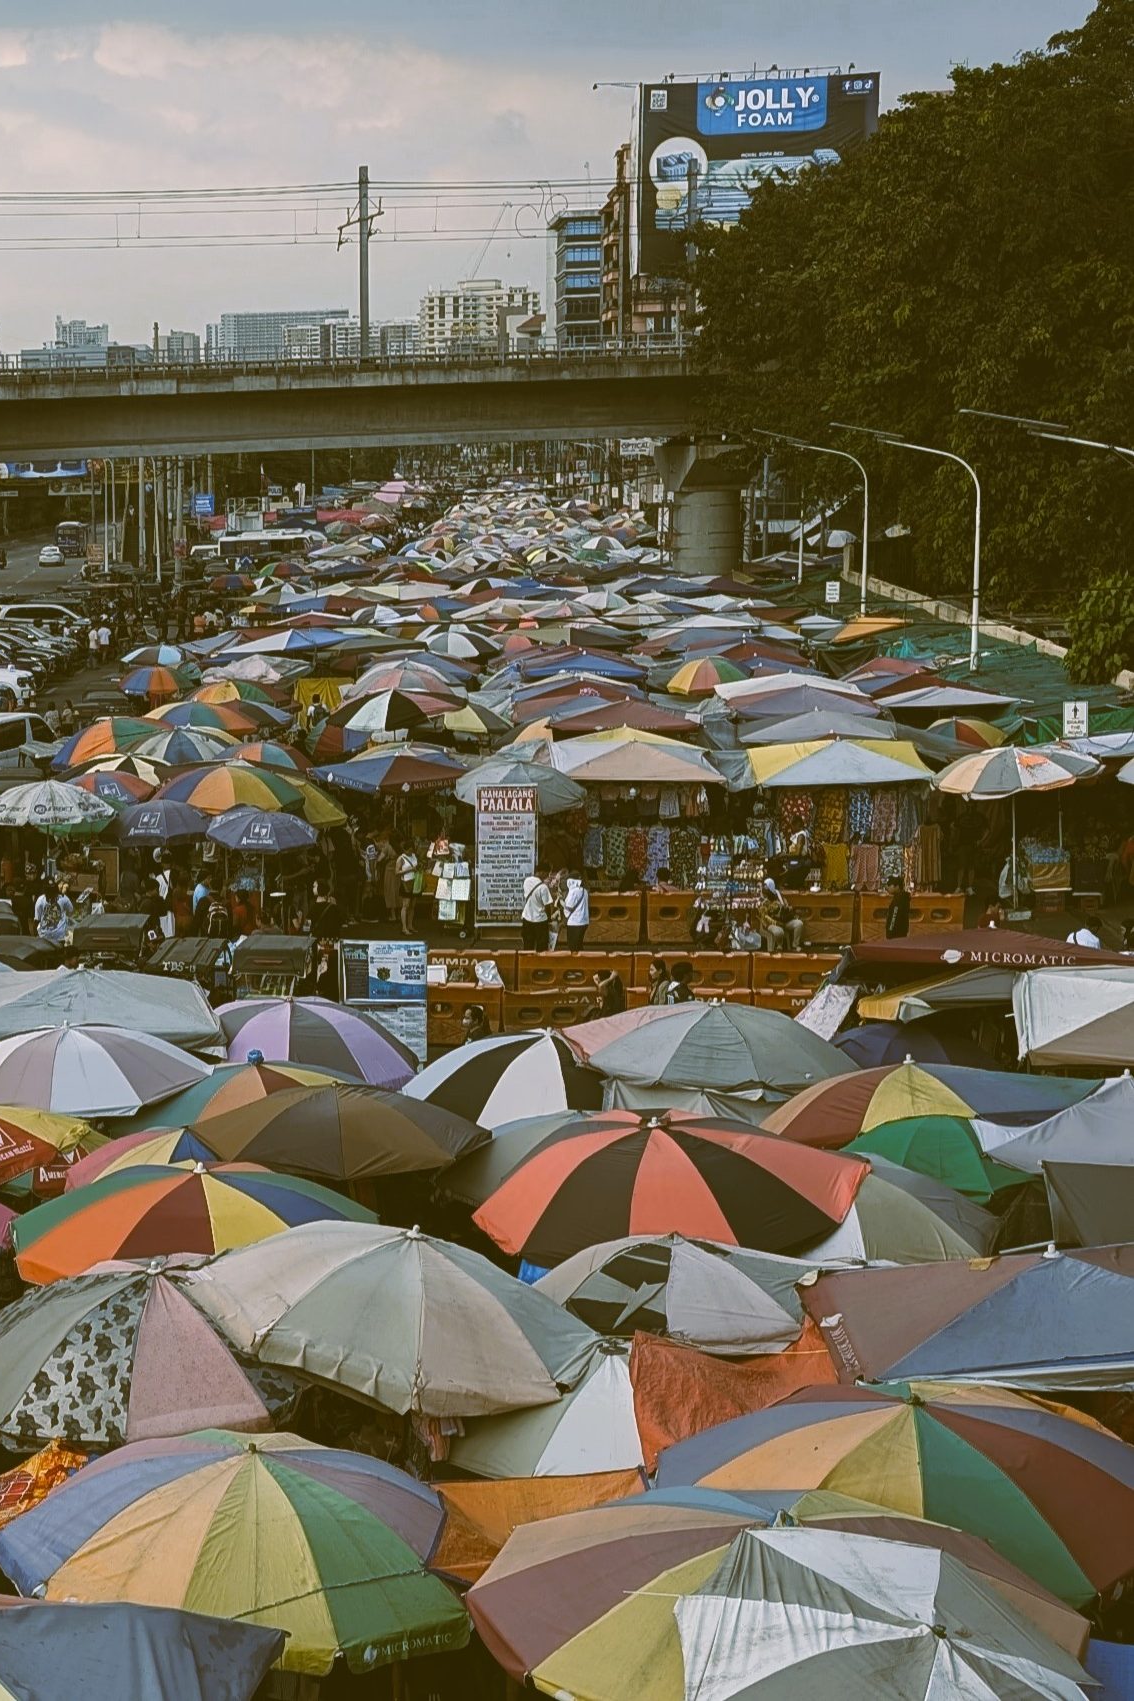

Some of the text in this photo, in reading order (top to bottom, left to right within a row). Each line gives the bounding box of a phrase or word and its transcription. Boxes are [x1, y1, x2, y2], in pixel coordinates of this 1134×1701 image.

[735, 87, 815, 111] JOLLY
[737, 111, 793, 127] FOAM
[481, 790, 534, 799] MAHALAGANG
[481, 798, 533, 811] PAALALA
[431, 957, 478, 966] MMDA
[970, 951, 1077, 965] MICROMATIC
[381, 1633, 453, 1656] MICROMATIC
